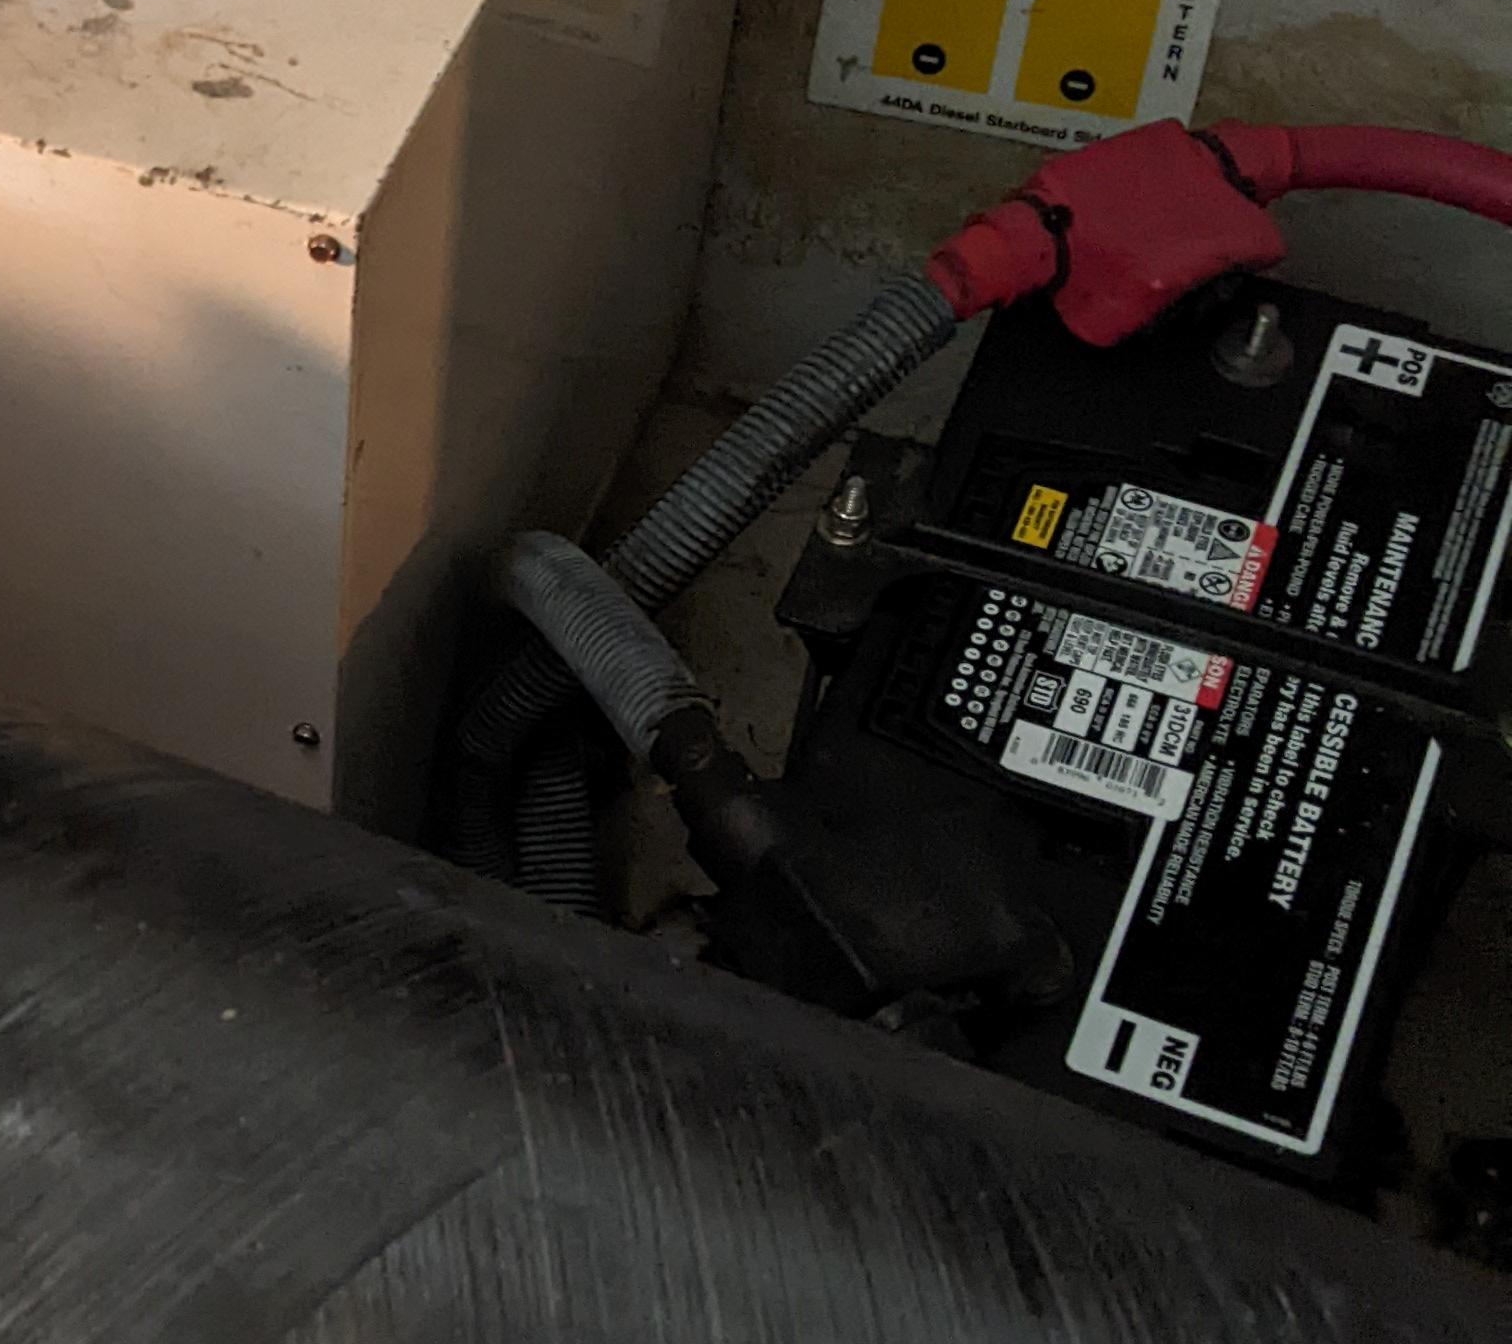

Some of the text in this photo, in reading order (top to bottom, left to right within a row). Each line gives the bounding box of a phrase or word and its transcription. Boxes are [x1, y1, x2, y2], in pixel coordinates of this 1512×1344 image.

[930, 102, 980, 124] Diesel
[986, 114, 1068, 140] Starboard
[1075, 129, 1103, 143] Sid
[1397, 346, 1425, 388] POS
[1330, 519, 1358, 555] fluid
[1228, 557, 1261, 612] DANGE
[1314, 554, 1346, 603] levels
[1333, 550, 1370, 614] Remove
[1351, 510, 1419, 652] MAINTENANC
[1327, 614, 1348, 632] &
[1027, 673, 1059, 707] STD
[1201, 652, 1227, 690] SON
[1069, 686, 1093, 715] 690
[1209, 663, 1252, 747] ELECTROLYTE
[1232, 665, 1272, 739] EPARATORS
[1269, 700, 1294, 733] has
[1294, 689, 1322, 725] this
[1158, 703, 1190, 758] 31DCM
[1279, 723, 1311, 768] label
[1253, 732, 1283, 777] been
[1273, 767, 1294, 788] to
[1246, 775, 1269, 797] in
[1263, 690, 1361, 912] CESSIBLE BATTERY
[1172, 765, 1236, 907] VIBRATION RESISTANCE
[1221, 794, 1260, 865] service.
[1253, 786, 1289, 844] check
[1144, 759, 1217, 928] AMERICAN MADE RELIABILITY
[1150, 1035, 1187, 1093] NEG
